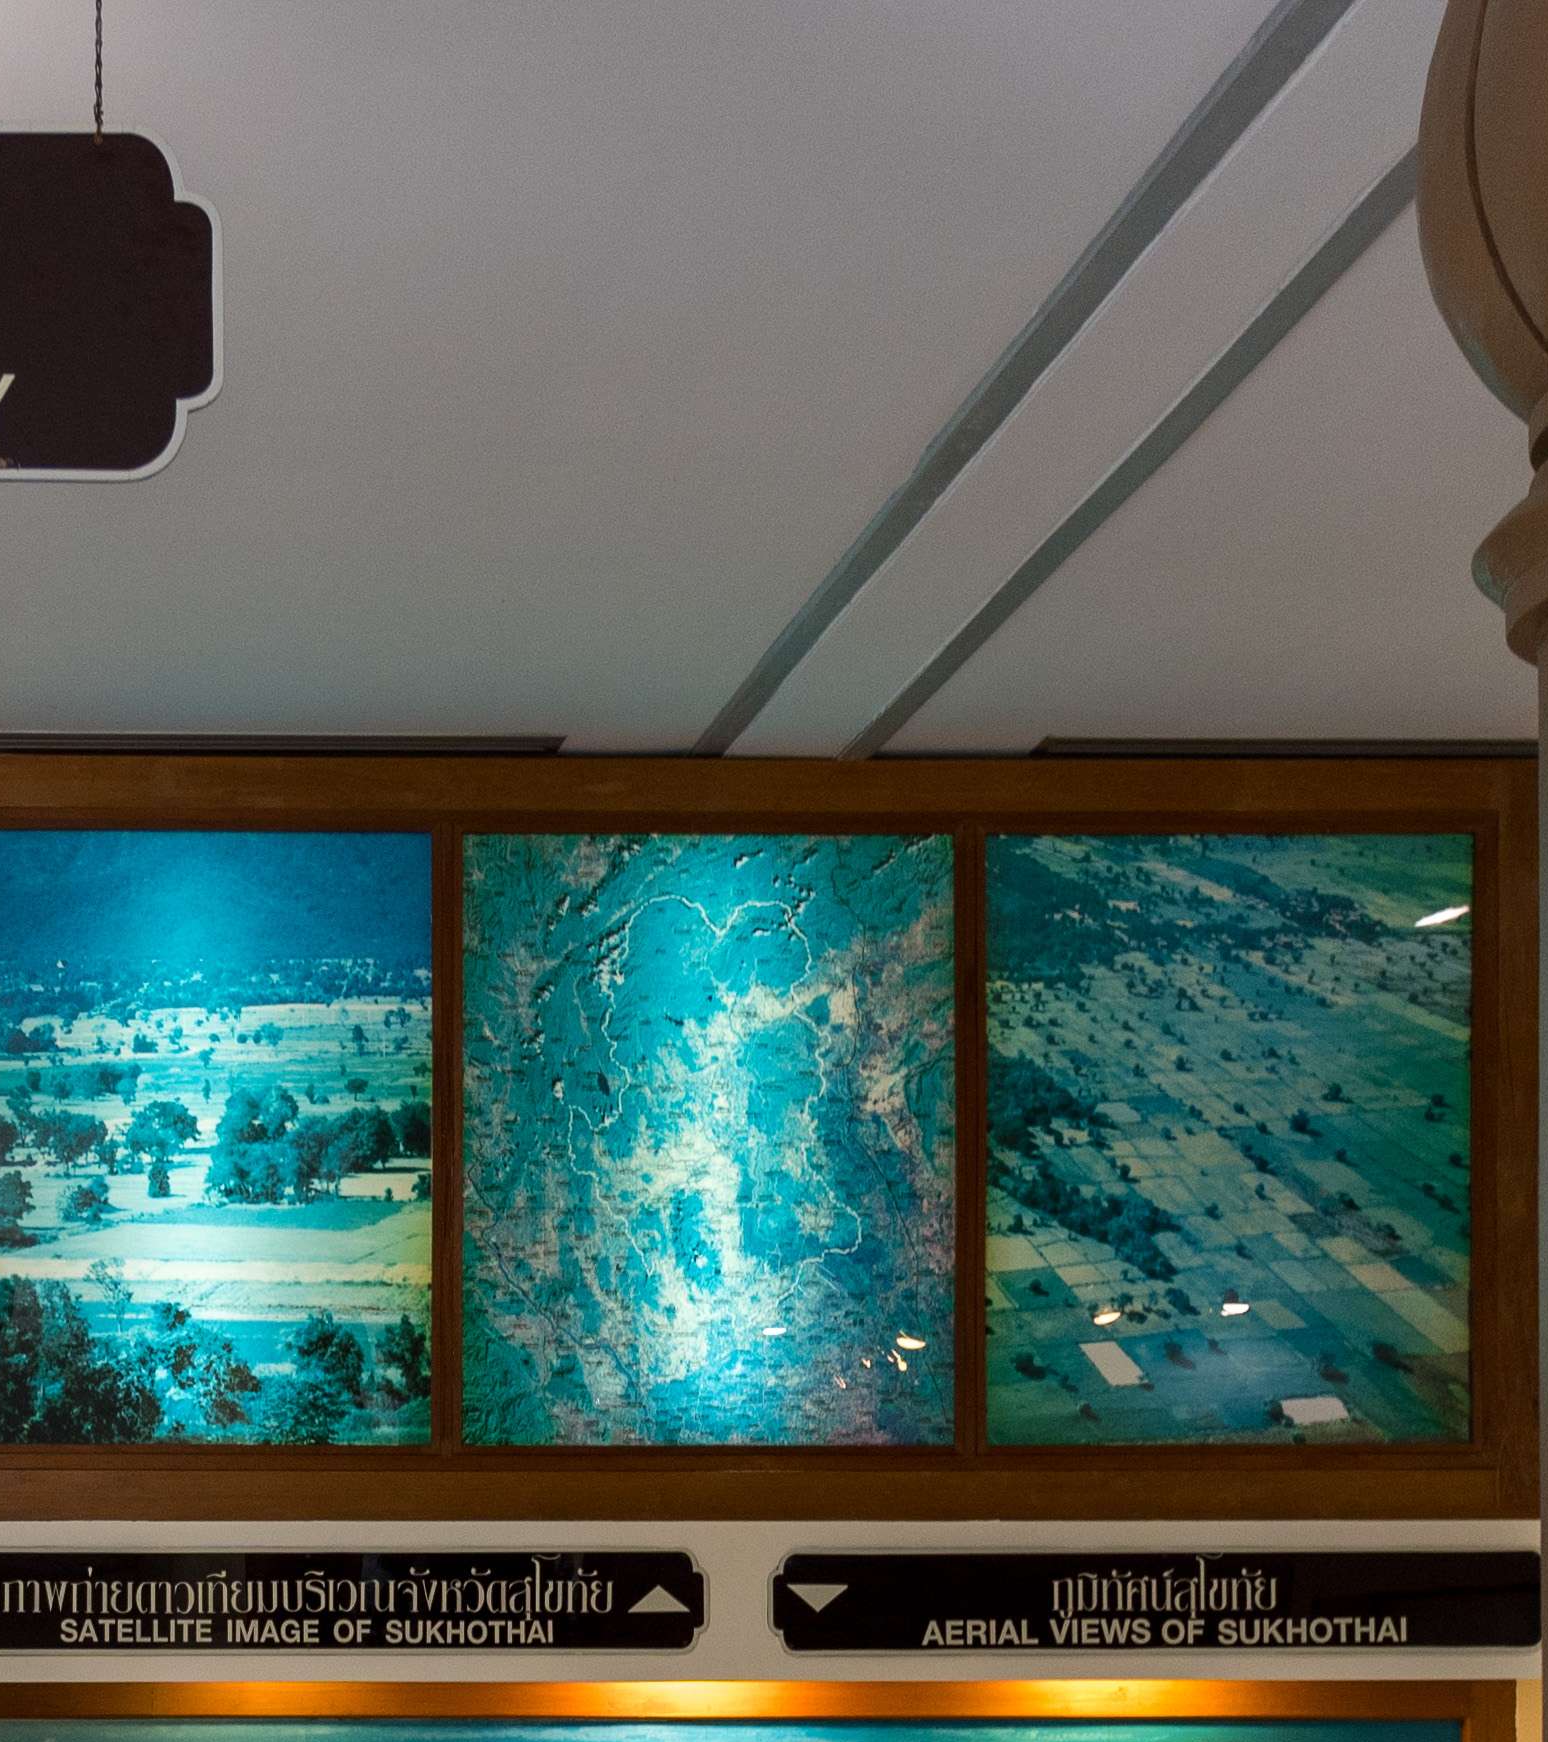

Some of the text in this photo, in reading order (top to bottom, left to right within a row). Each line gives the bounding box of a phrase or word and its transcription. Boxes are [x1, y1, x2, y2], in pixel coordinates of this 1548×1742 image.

[2, 1554, 613, 1621] ภาพถ่ายดาวเทียมบริเวณจังหวัดสุโขทัย
[1052, 1552, 1278, 1619] ภูมิทัศน์สุโขทัย
[60, 1618, 554, 1644] SATELLITE IMAGE OF SUKHOTHAI
[921, 1616, 1407, 1646] AERIAL VIEWS OF SUKHOTHAI
